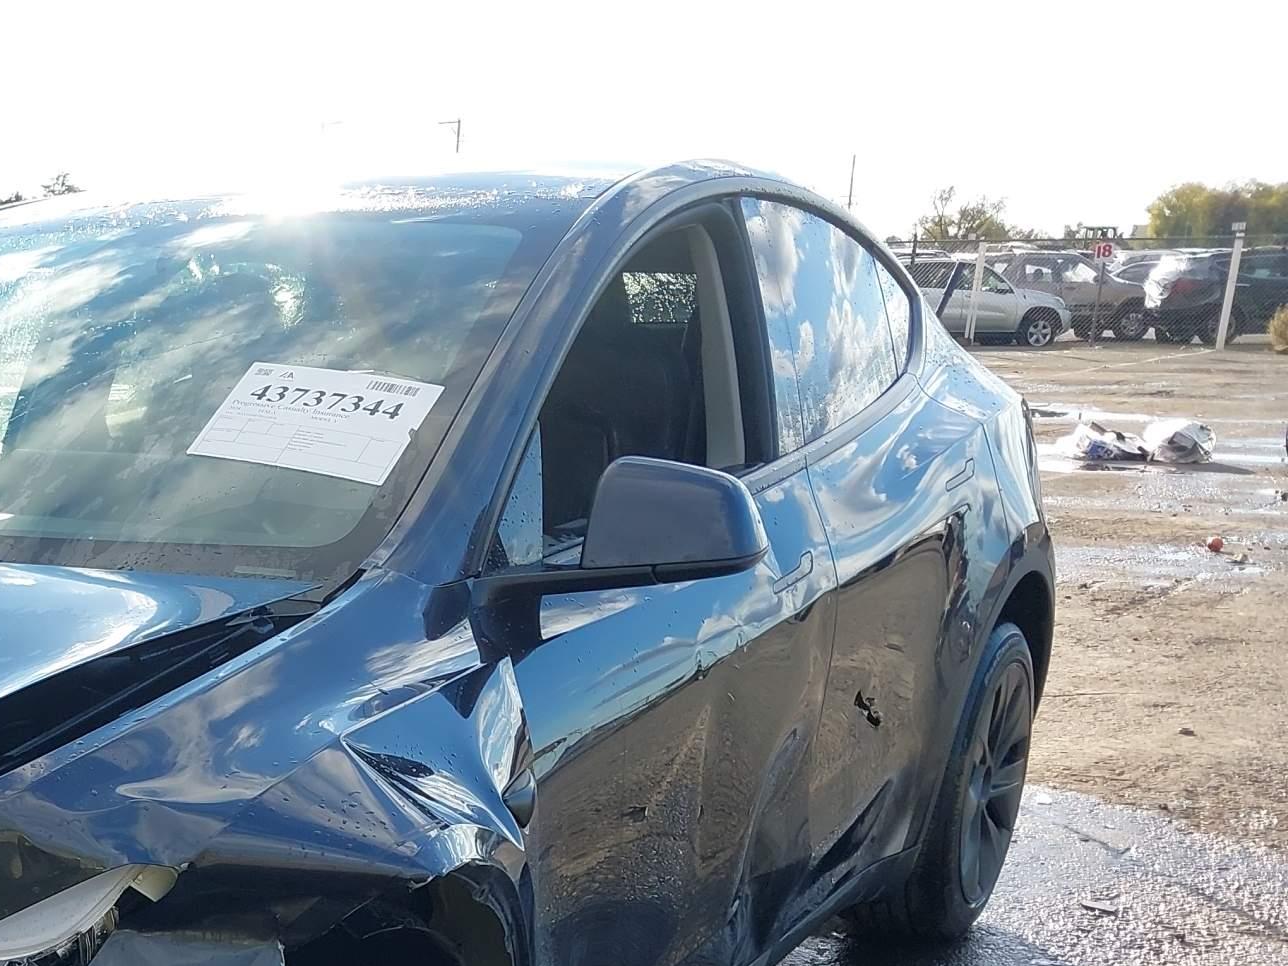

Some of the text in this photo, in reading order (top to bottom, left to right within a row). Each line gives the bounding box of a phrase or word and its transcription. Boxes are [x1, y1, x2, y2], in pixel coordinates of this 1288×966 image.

[1096, 244, 1112, 259] 18
[250, 384, 405, 420] 43737344
[277, 405, 310, 415] Casualty
[312, 408, 351, 419] Insurance
